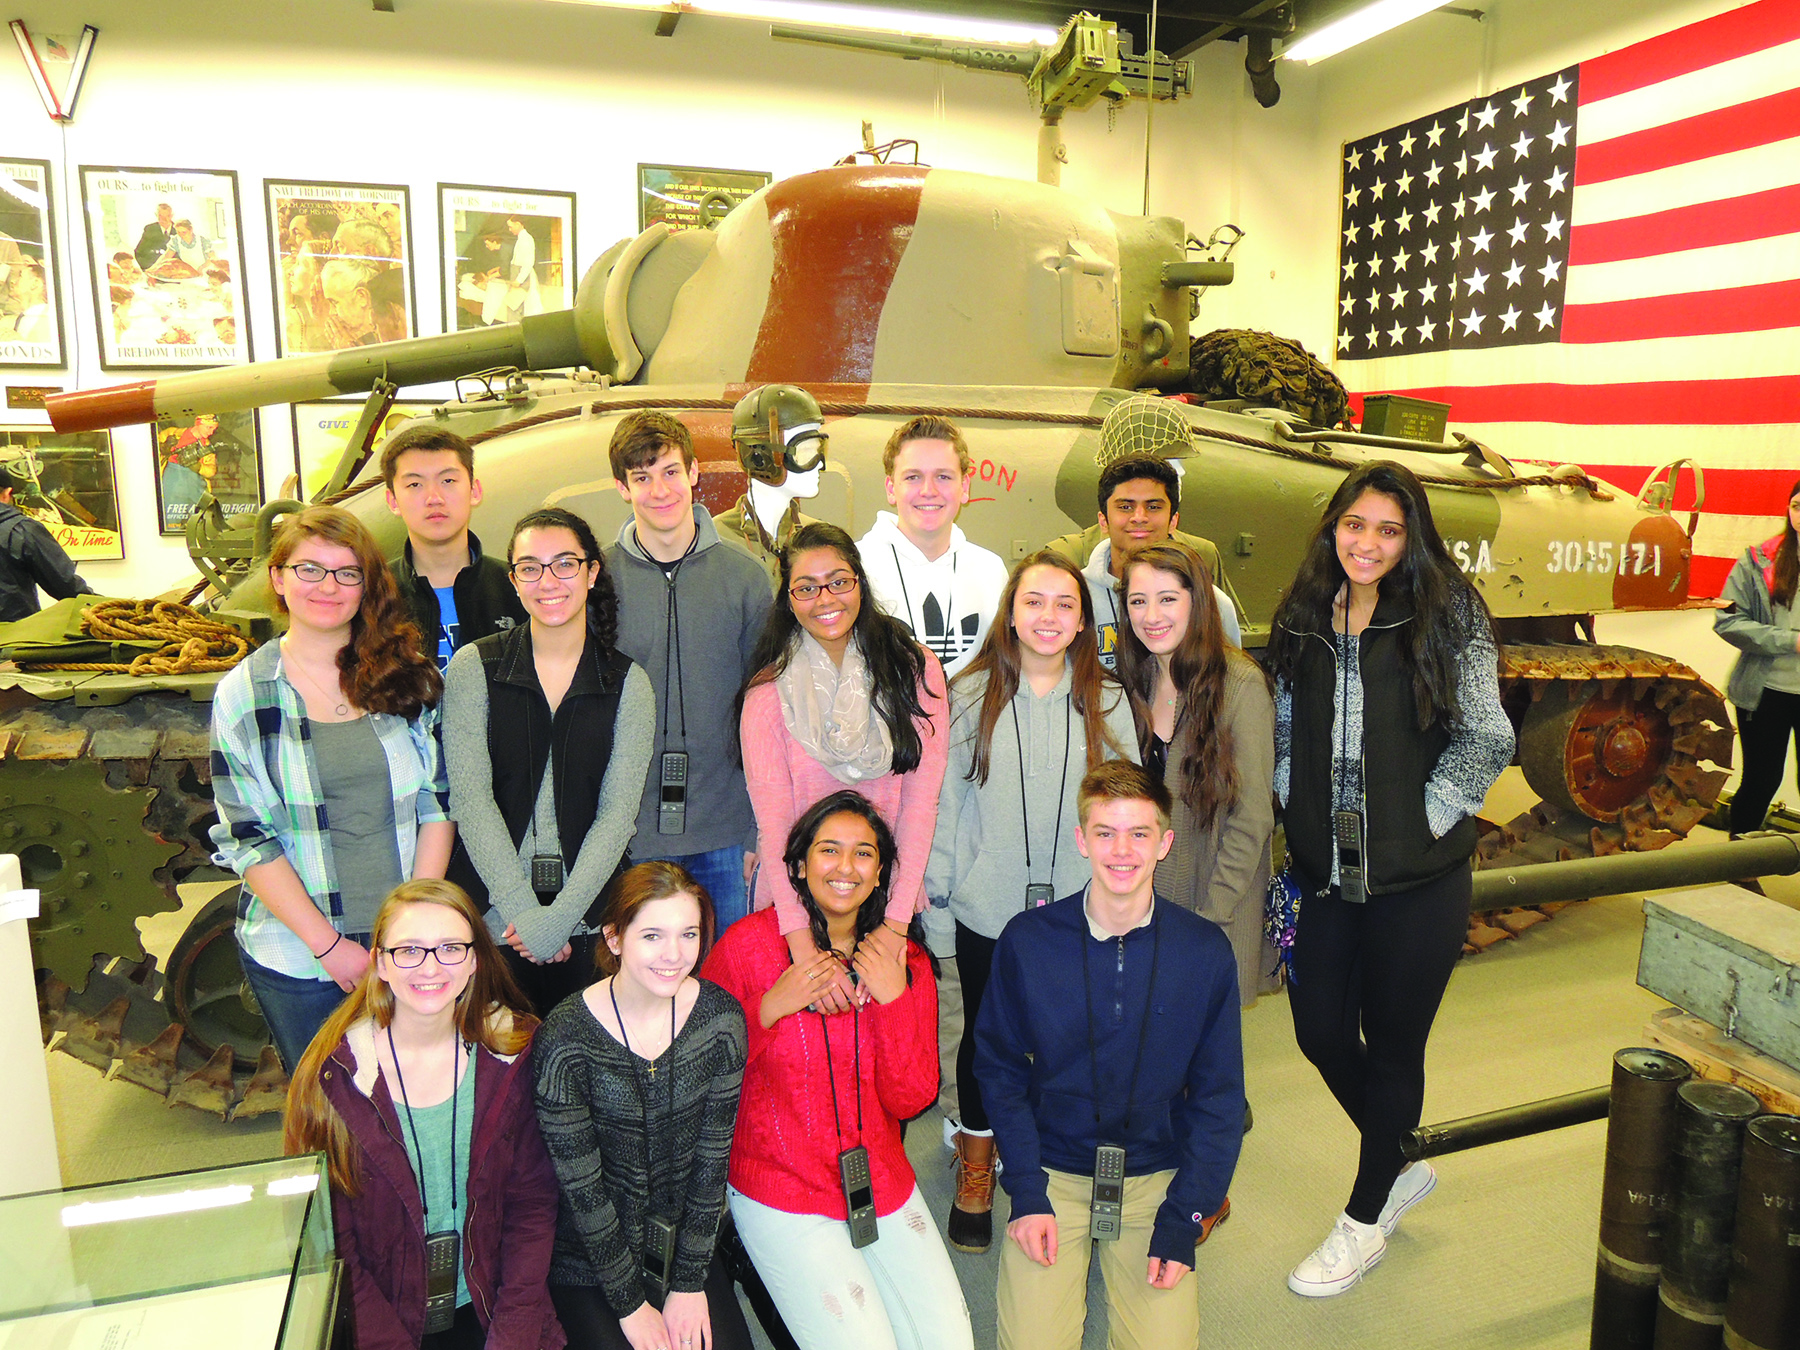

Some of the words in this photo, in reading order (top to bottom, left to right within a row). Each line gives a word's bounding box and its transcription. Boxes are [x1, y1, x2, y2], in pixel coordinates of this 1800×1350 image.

[142, 183, 152, 191] to
[154, 181, 177, 193] fight
[181, 182, 195, 192] for
[299, 187, 341, 198] FREEDOM
[359, 190, 400, 200] WORSHIP
[117, 347, 169, 358] FREEDOM
[174, 347, 203, 358] FROM
[207, 346, 236, 358] WANT
[318, 420, 350, 429] GIVE
[166, 503, 189, 514] FREE
[221, 504, 231, 514] TO
[231, 503, 256, 514] FIGHT
[57, 528, 79, 547] On
[80, 529, 113, 547] Time
